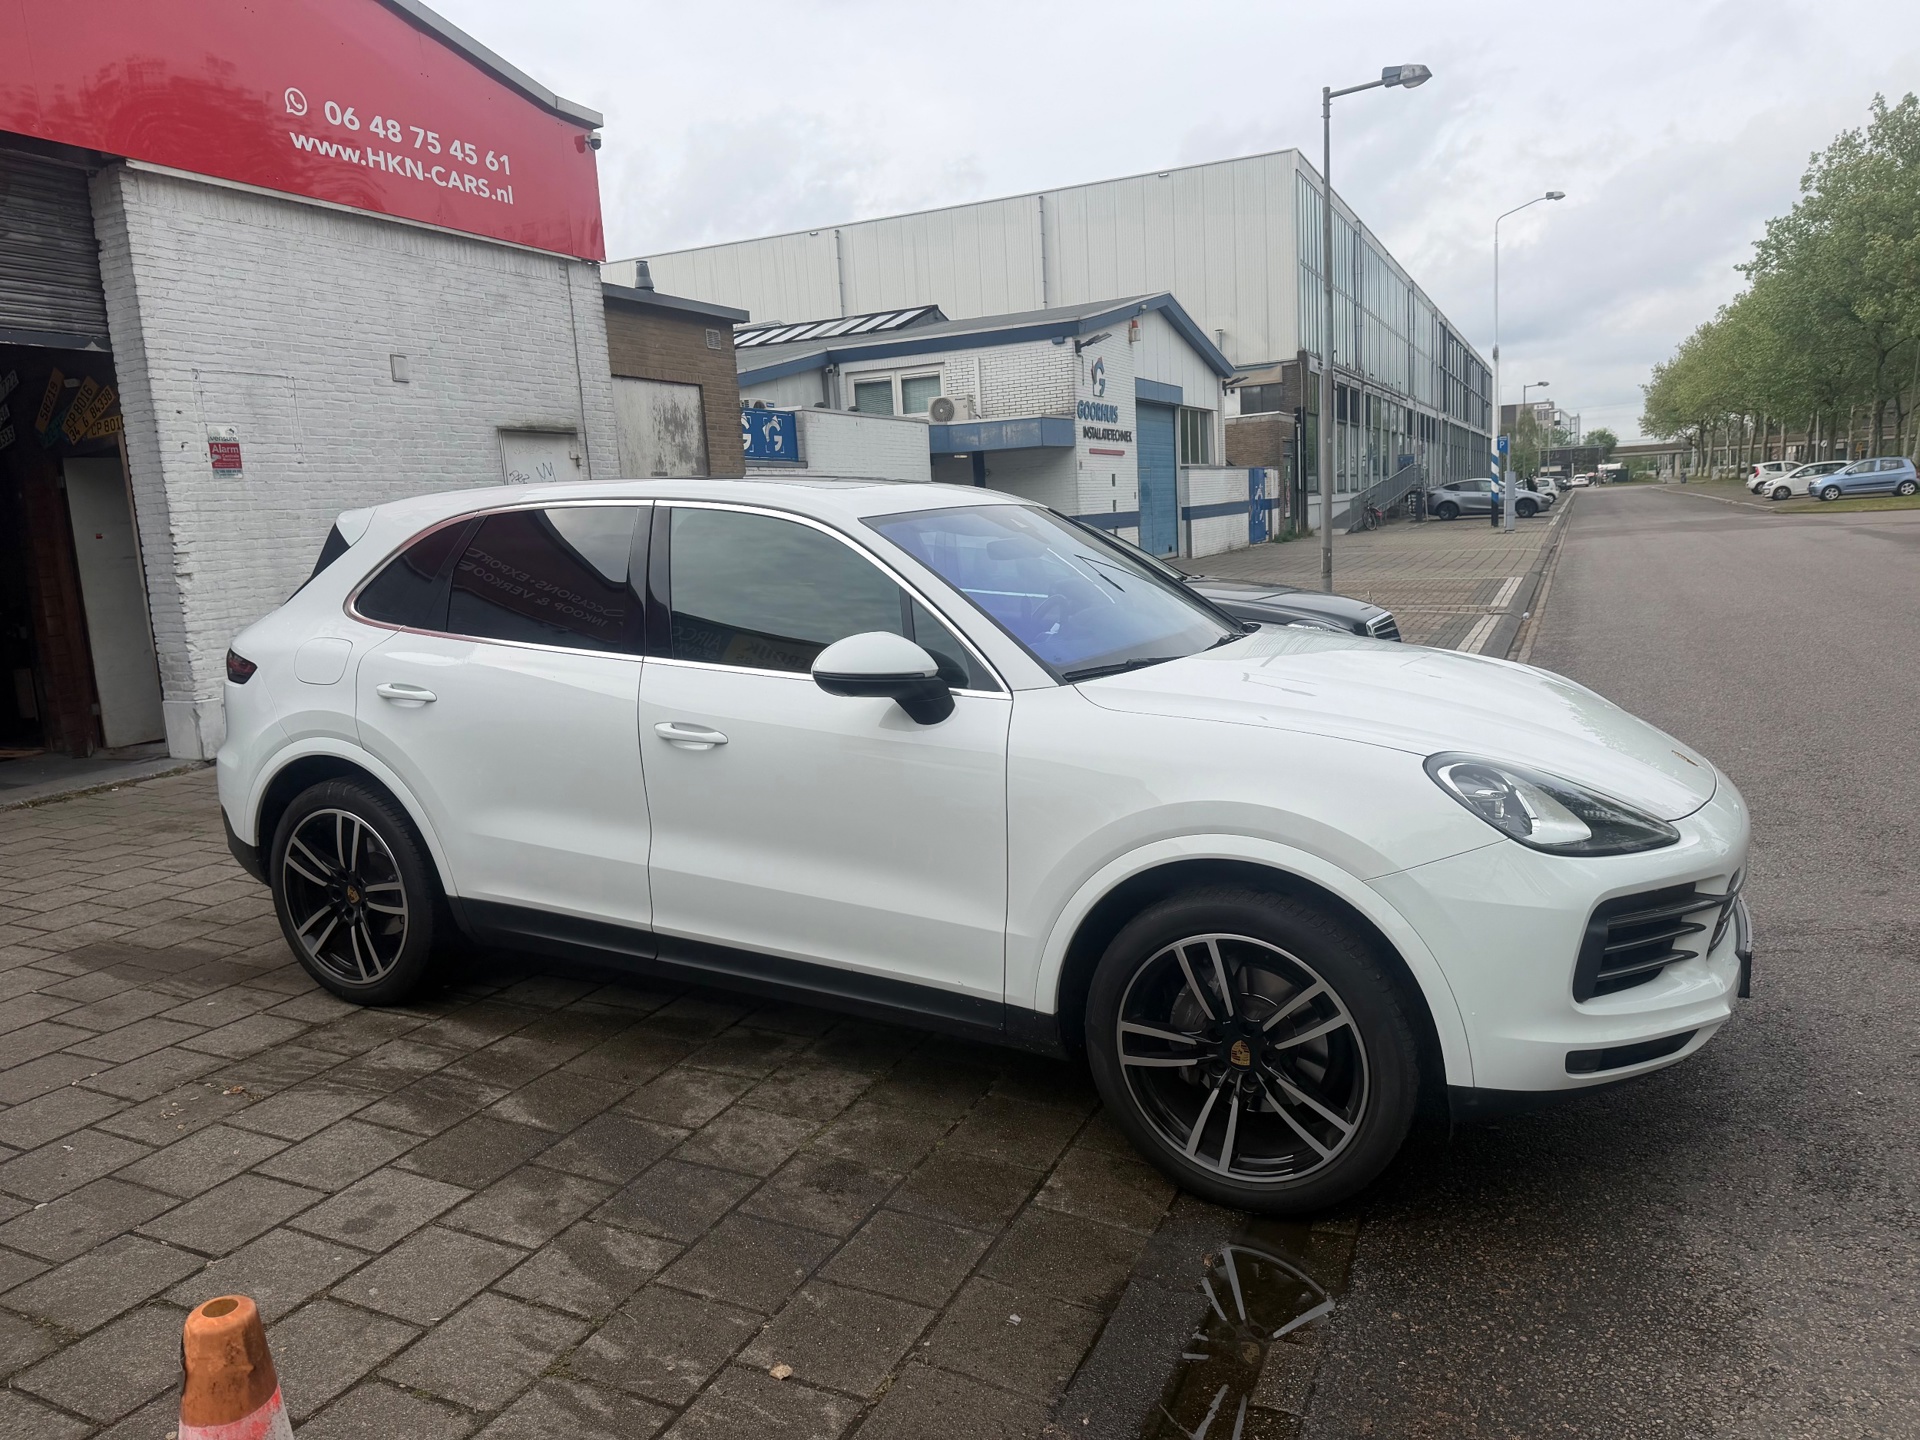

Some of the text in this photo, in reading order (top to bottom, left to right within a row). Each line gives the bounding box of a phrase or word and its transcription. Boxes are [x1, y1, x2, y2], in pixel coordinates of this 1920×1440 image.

[324, 101, 511, 175] 06 48 75 45 61
[289, 131, 514, 205] www.HKN-CARS.nl
[73, 385, 94, 414] 8016
[1077, 400, 1118, 423] GOORHUIS
[212, 444, 239, 453] Alarm
[1499, 440, 1505, 449] P
